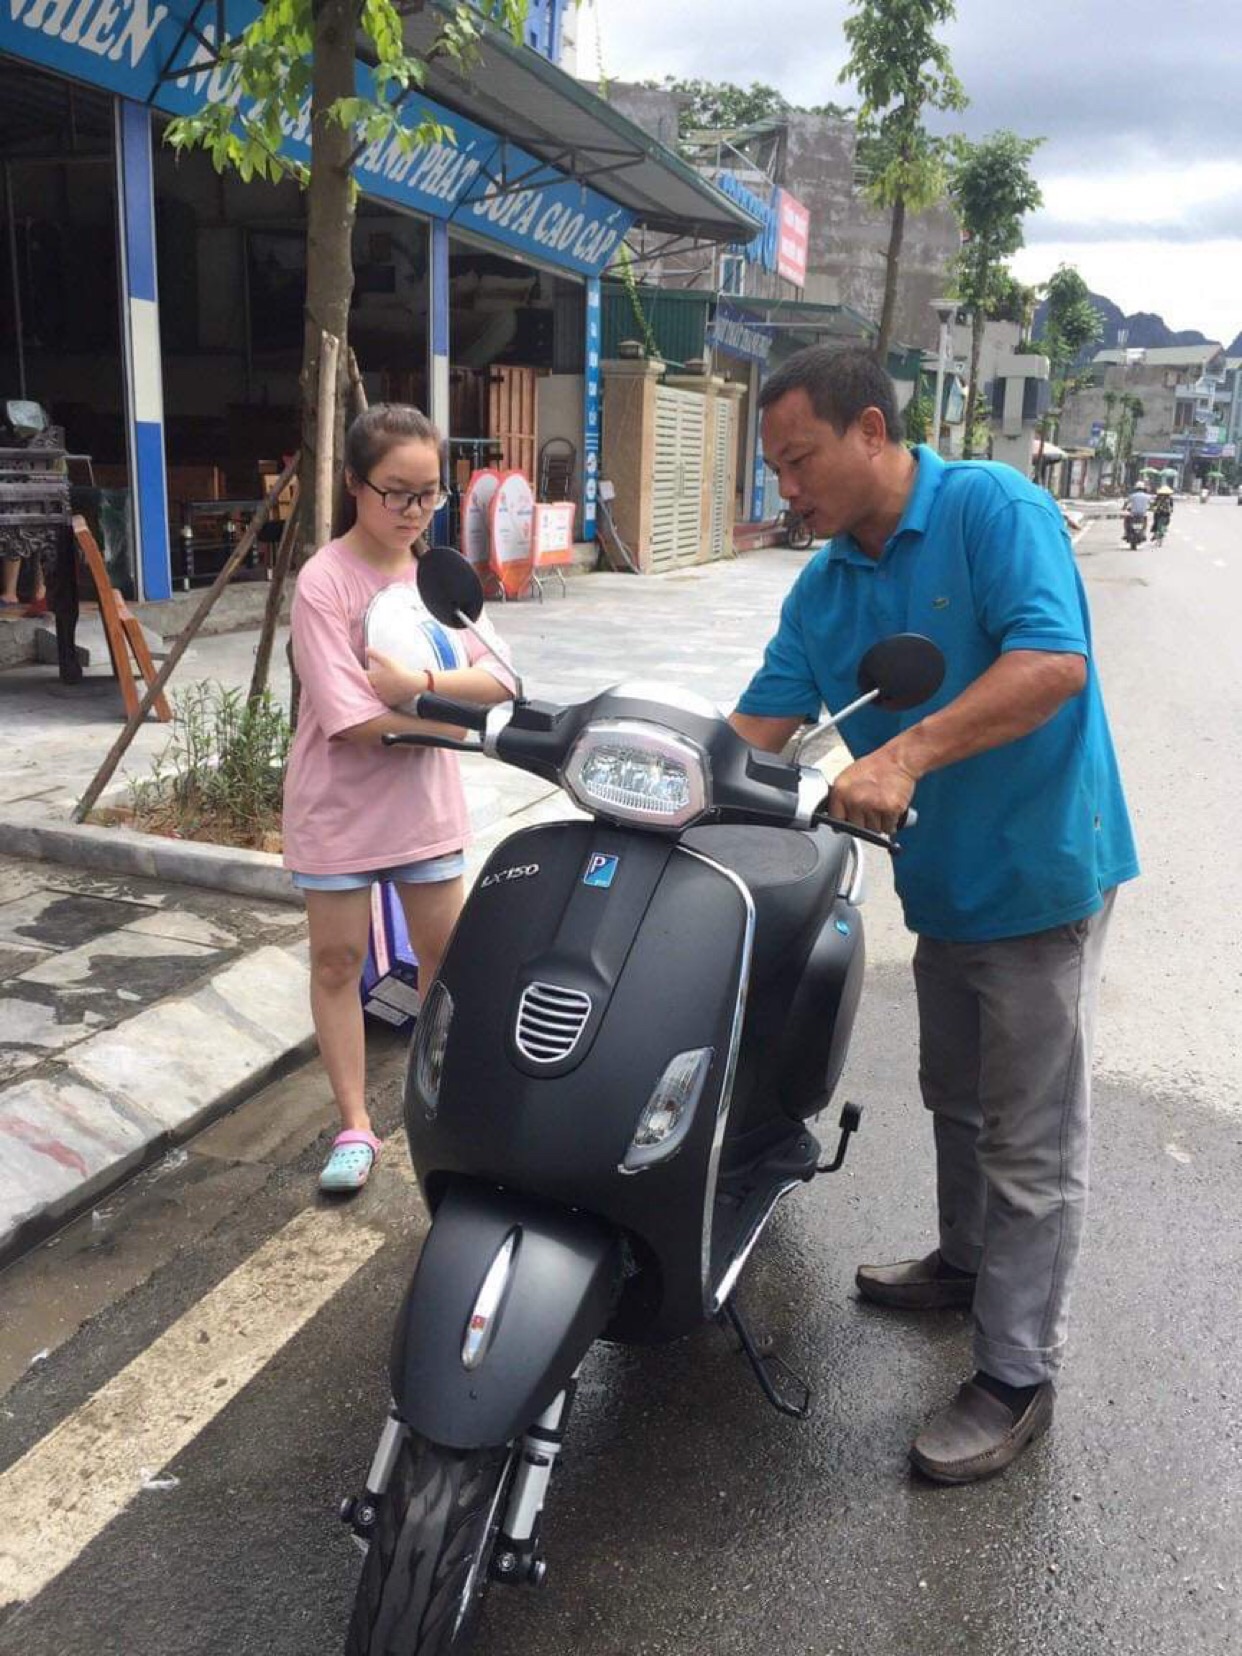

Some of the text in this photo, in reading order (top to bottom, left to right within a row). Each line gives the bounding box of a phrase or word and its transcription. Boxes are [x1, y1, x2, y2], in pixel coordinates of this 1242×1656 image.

[407, 140, 480, 201] PHÁT
[473, 172, 543, 235] SOFA
[533, 202, 585, 250] CAO
